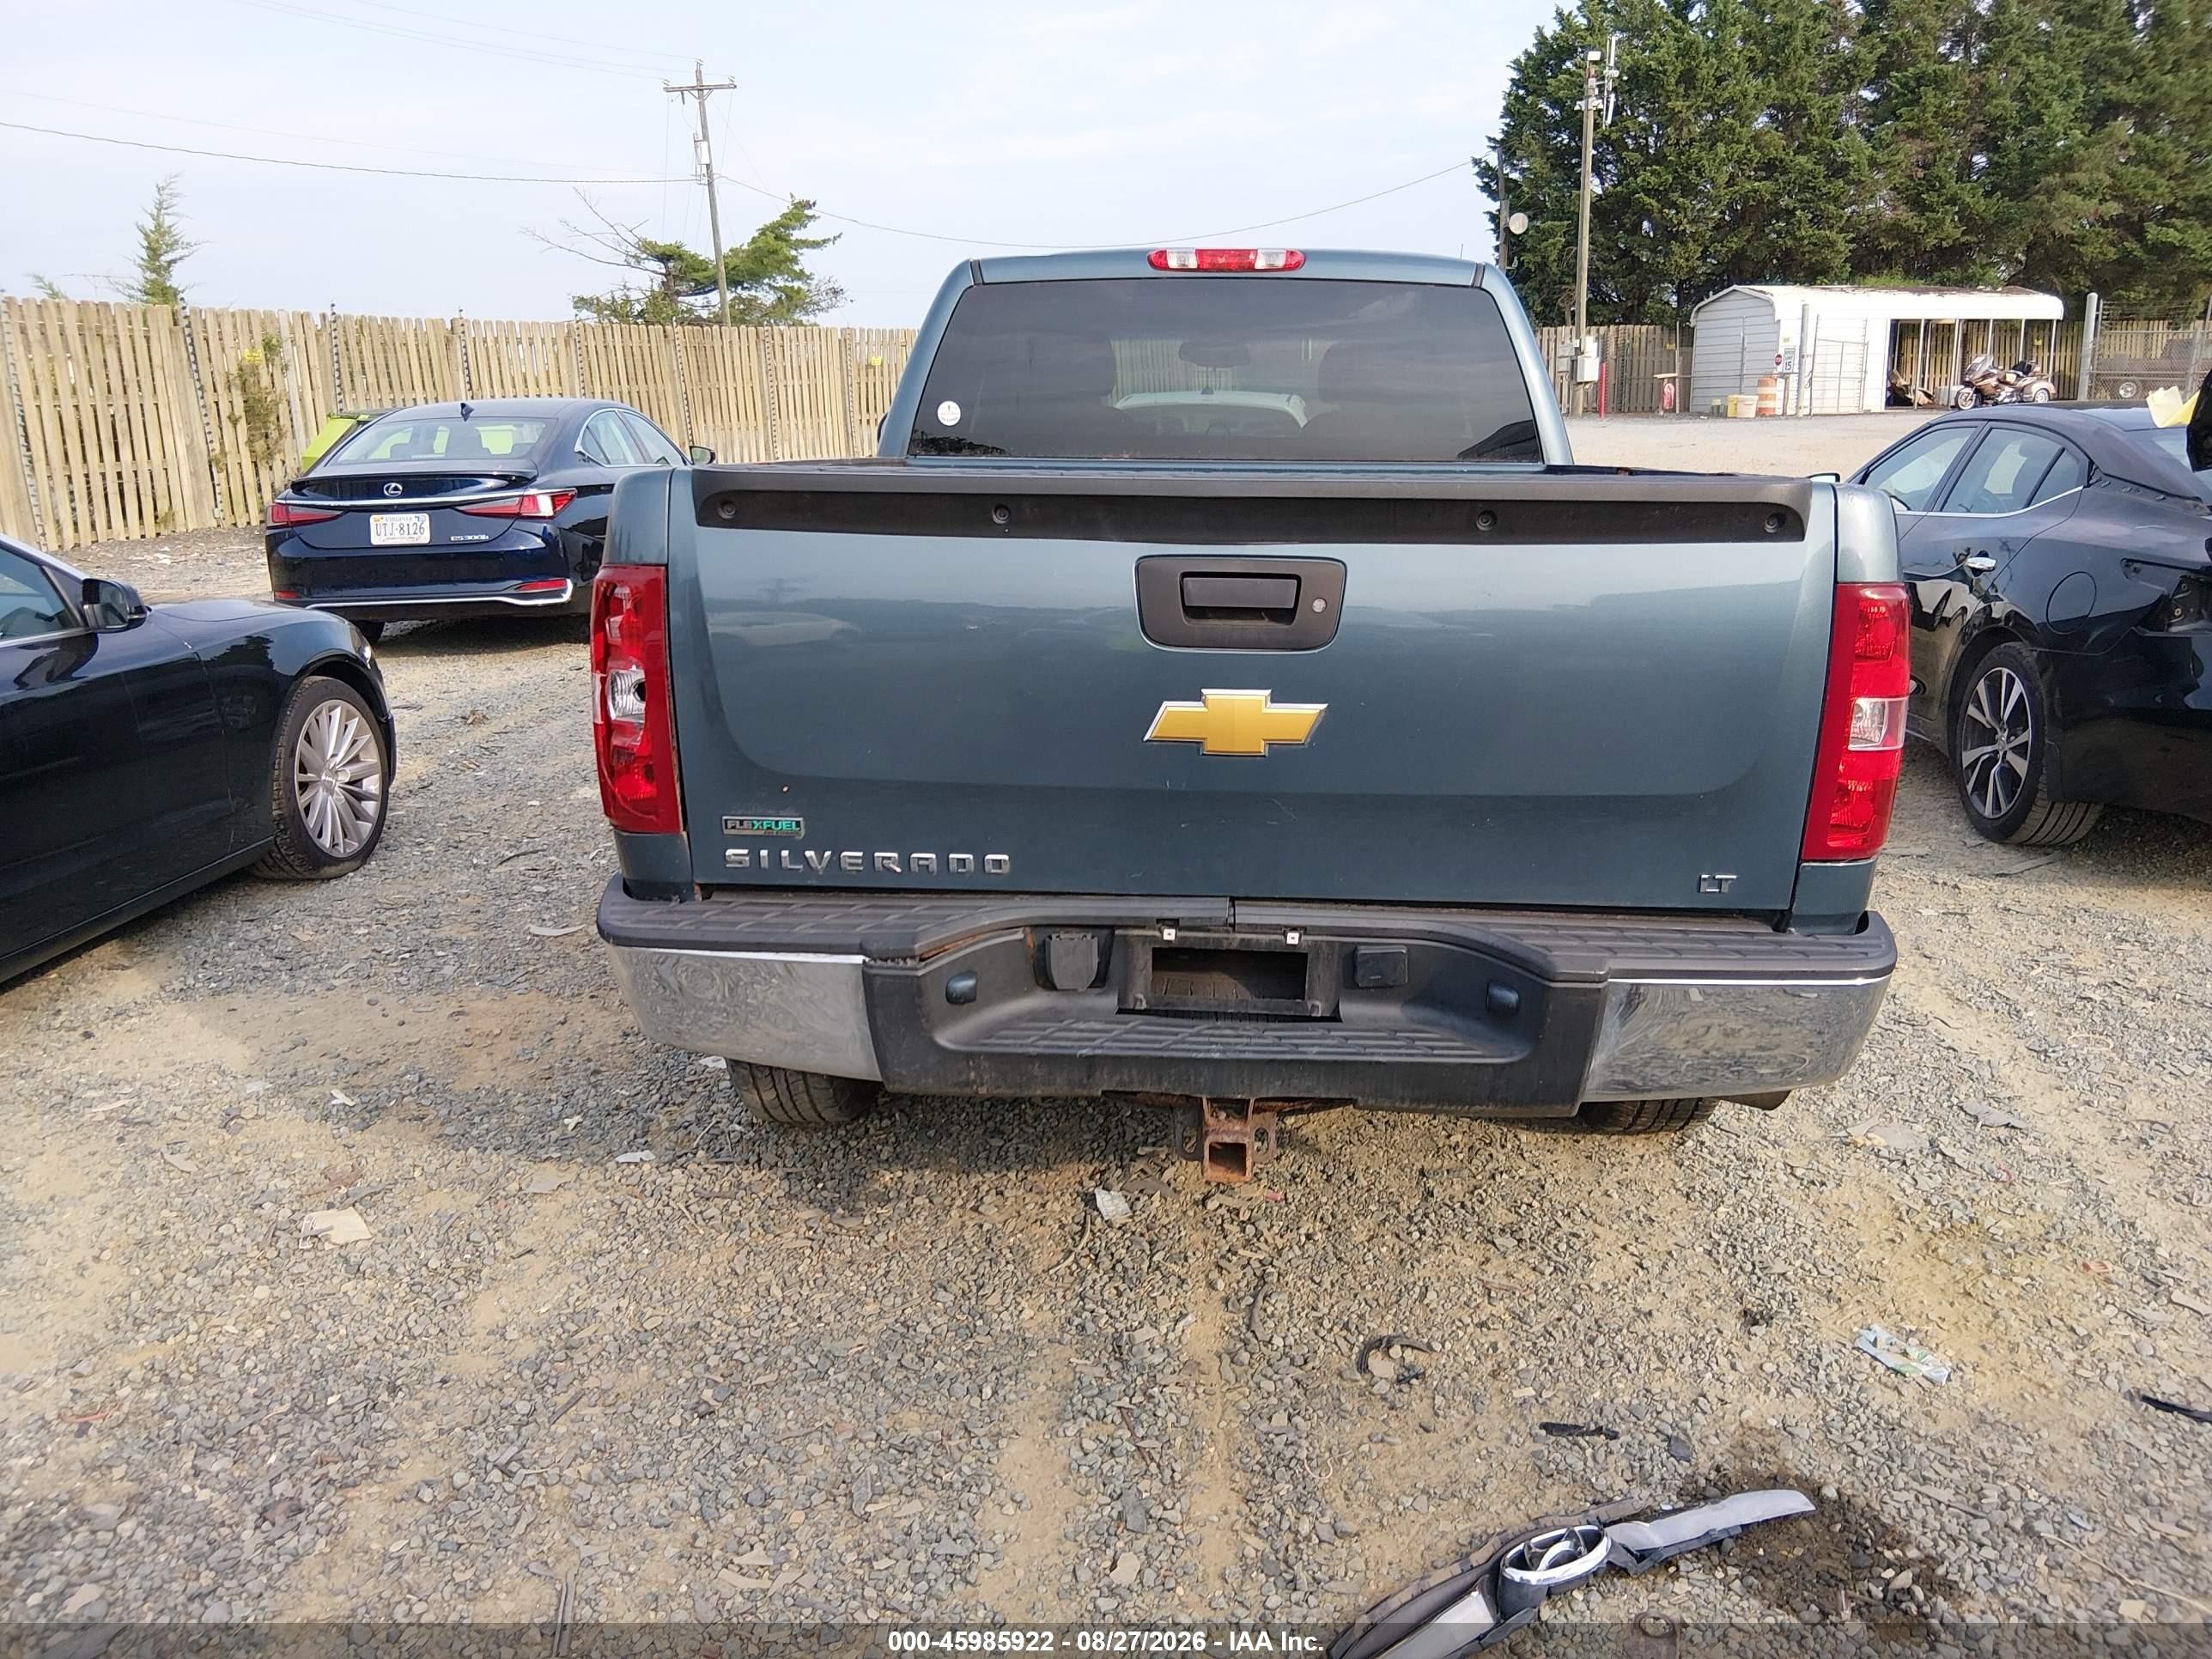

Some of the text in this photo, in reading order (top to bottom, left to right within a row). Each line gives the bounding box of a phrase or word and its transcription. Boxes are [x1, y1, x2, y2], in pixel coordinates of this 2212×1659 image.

[1785, 361, 1792, 370] 15
[375, 522, 425, 537] UTJ-8126
[726, 819, 800, 831] FLEXFUEL
[725, 848, 1011, 874] SILVERADO
[1699, 874, 1739, 893] LT
